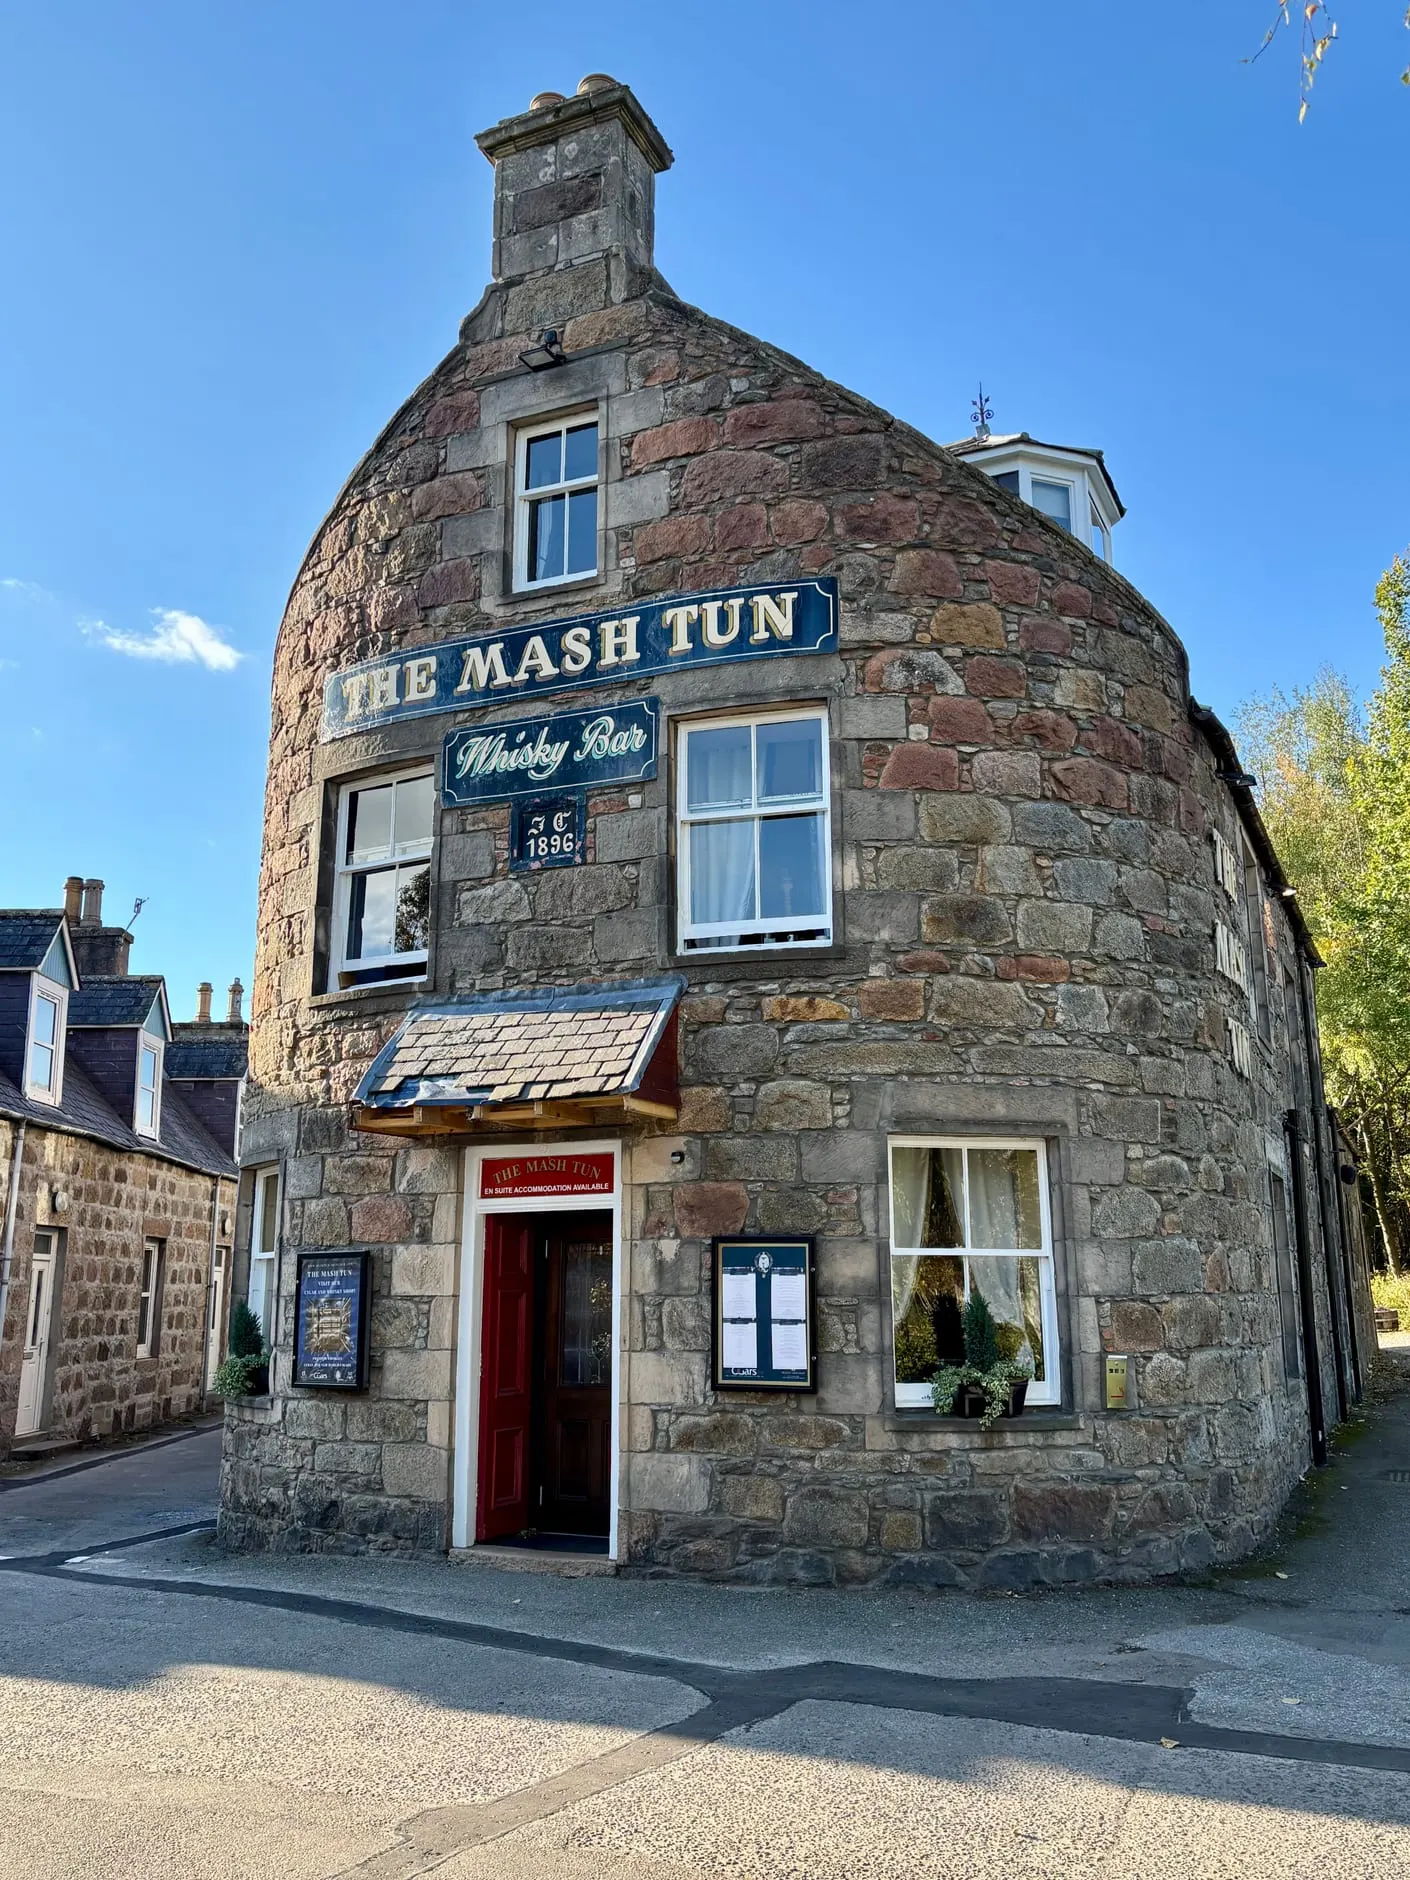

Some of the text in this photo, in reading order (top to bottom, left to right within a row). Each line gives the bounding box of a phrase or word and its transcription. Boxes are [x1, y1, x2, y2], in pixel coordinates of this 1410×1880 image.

[342, 591, 798, 722] THE MASH TUN
[456, 716, 647, 780] Whisky Bar
[526, 832, 574, 858] 1896
[492, 1158, 601, 1185] THE MASH TUN
[494, 1186, 513, 1194] SUITE
[514, 1184, 572, 1194] ACCOMMODATION
[573, 1182, 609, 1191] AVAILABLE
